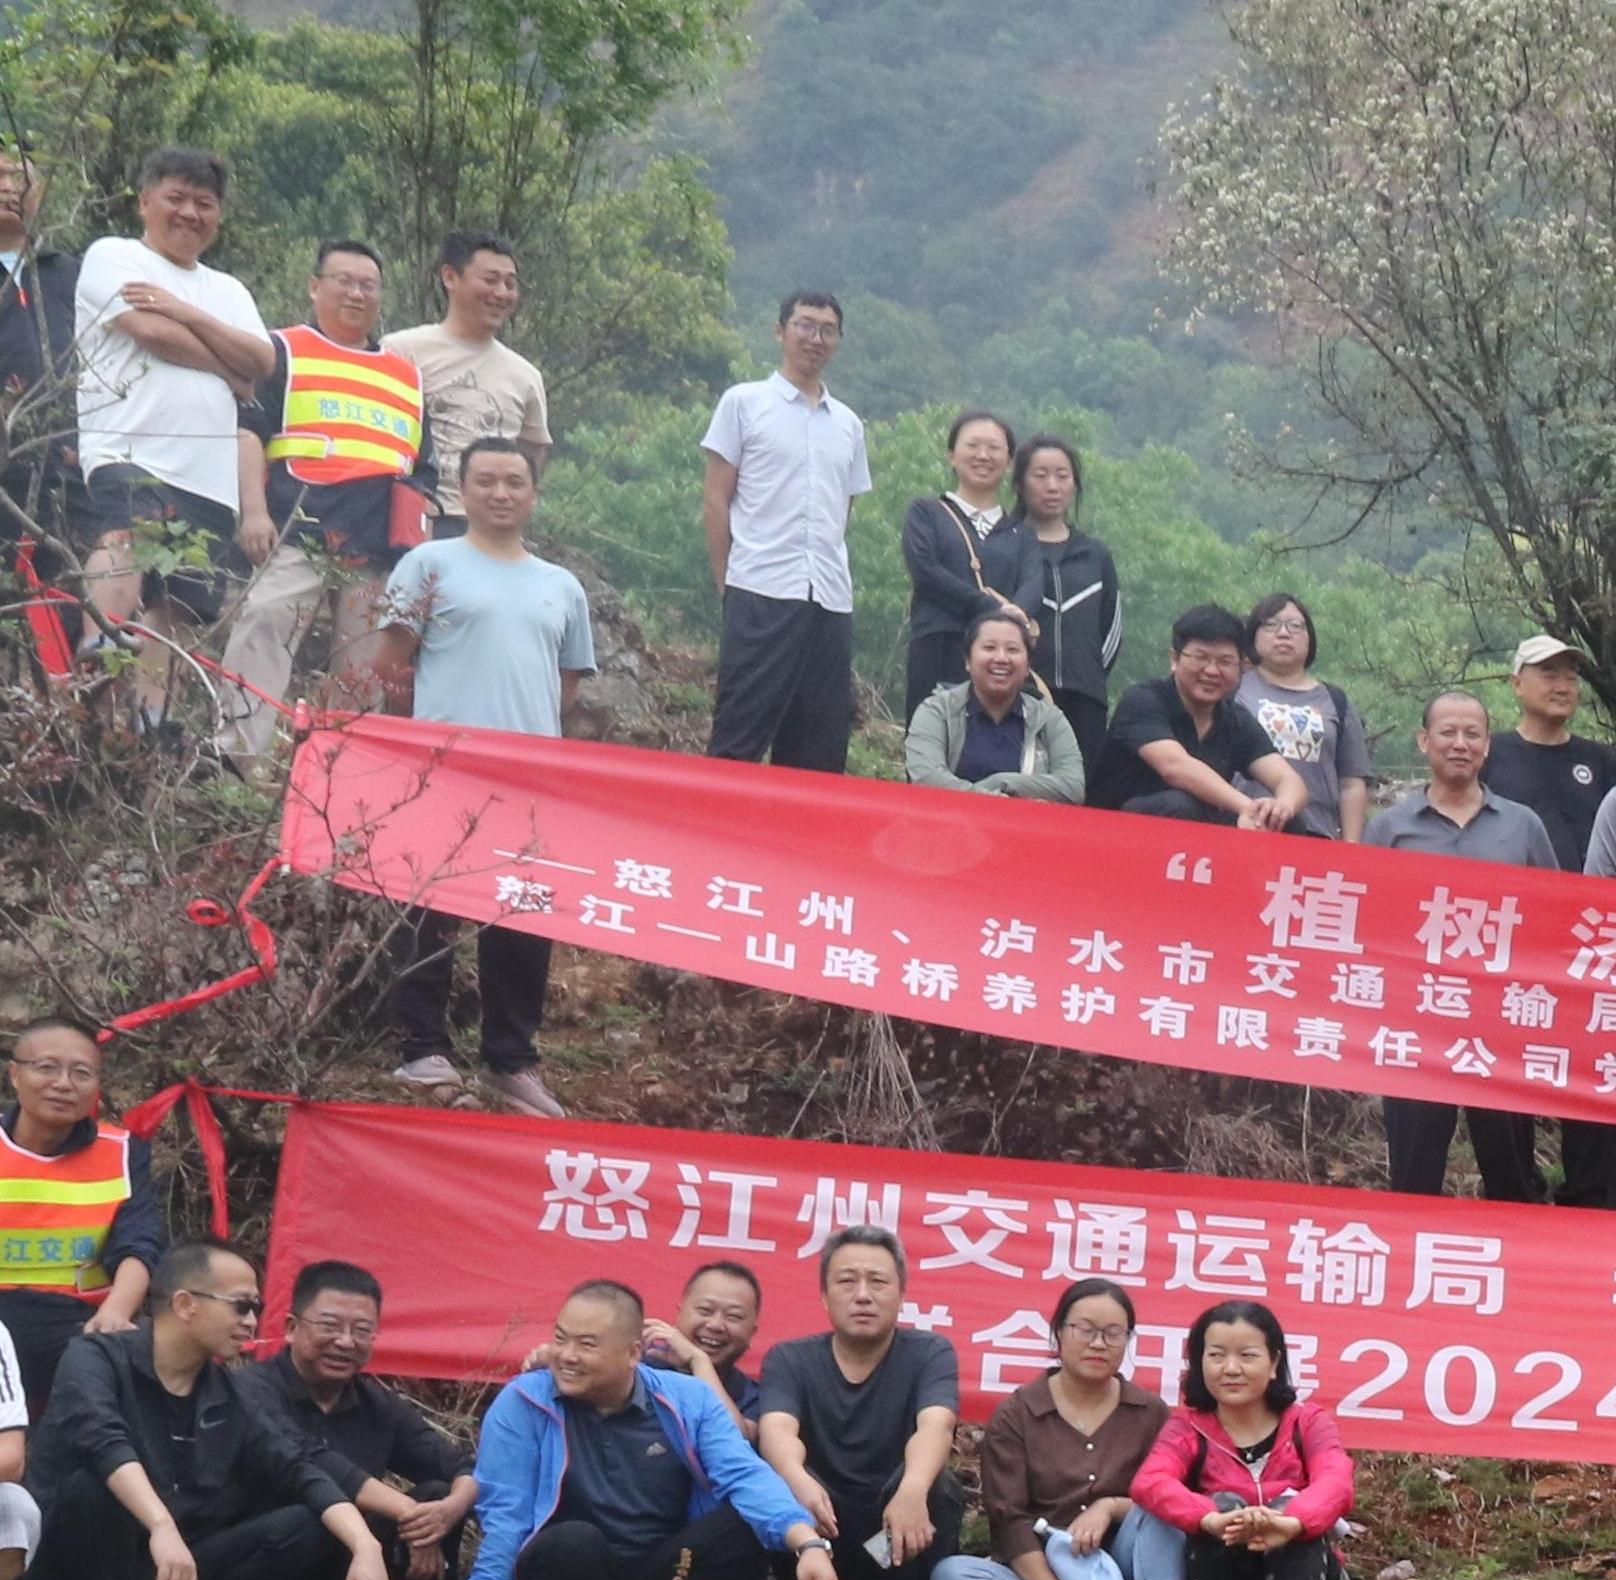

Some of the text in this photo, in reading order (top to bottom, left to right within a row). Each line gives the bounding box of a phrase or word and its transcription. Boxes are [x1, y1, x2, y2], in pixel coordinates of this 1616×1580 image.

[540, 1149, 1506, 1315] 怒江州交通运输局
